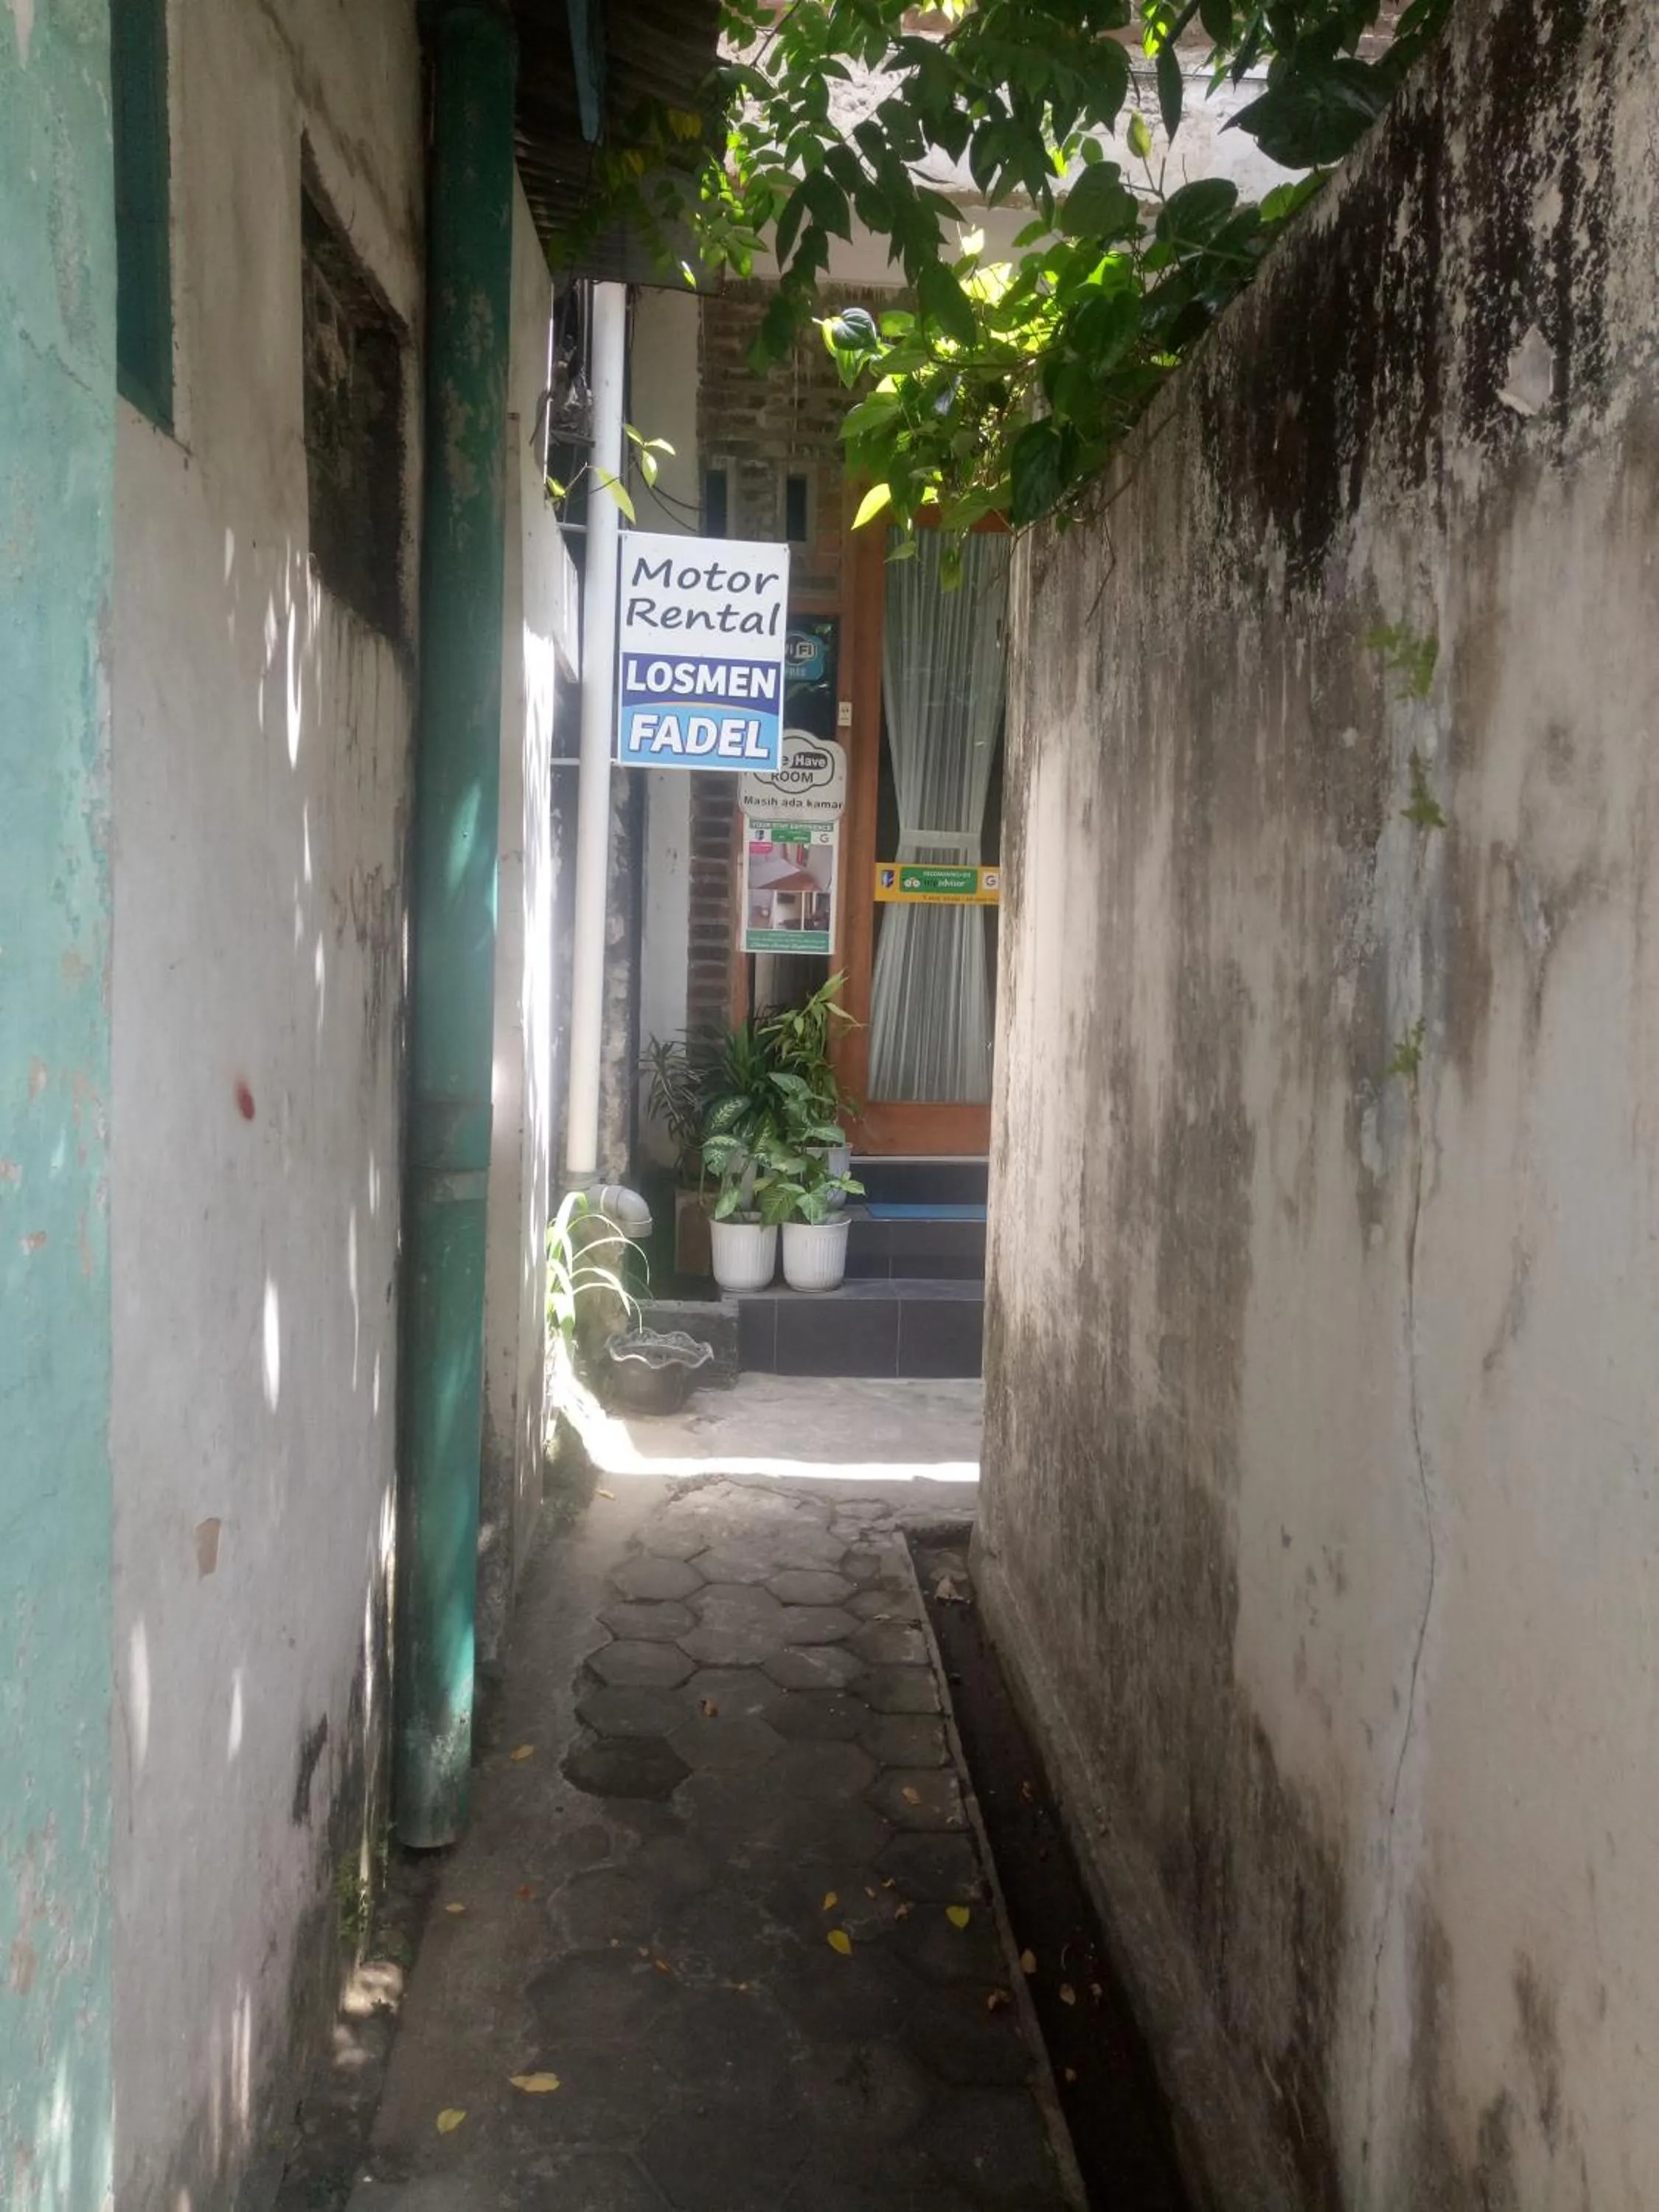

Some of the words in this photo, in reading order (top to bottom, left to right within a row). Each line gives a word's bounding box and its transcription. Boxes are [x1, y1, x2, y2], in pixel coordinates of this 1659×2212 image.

[632, 557, 779, 594] Motor
[627, 598, 780, 636] Rental
[627, 660, 776, 699] LOSMEN
[628, 714, 770, 759] FADEL
[771, 770, 813, 782] ROOM
[796, 754, 826, 768] Have
[744, 796, 778, 806] Masih
[782, 798, 803, 807] ada
[807, 799, 844, 810] kamar
